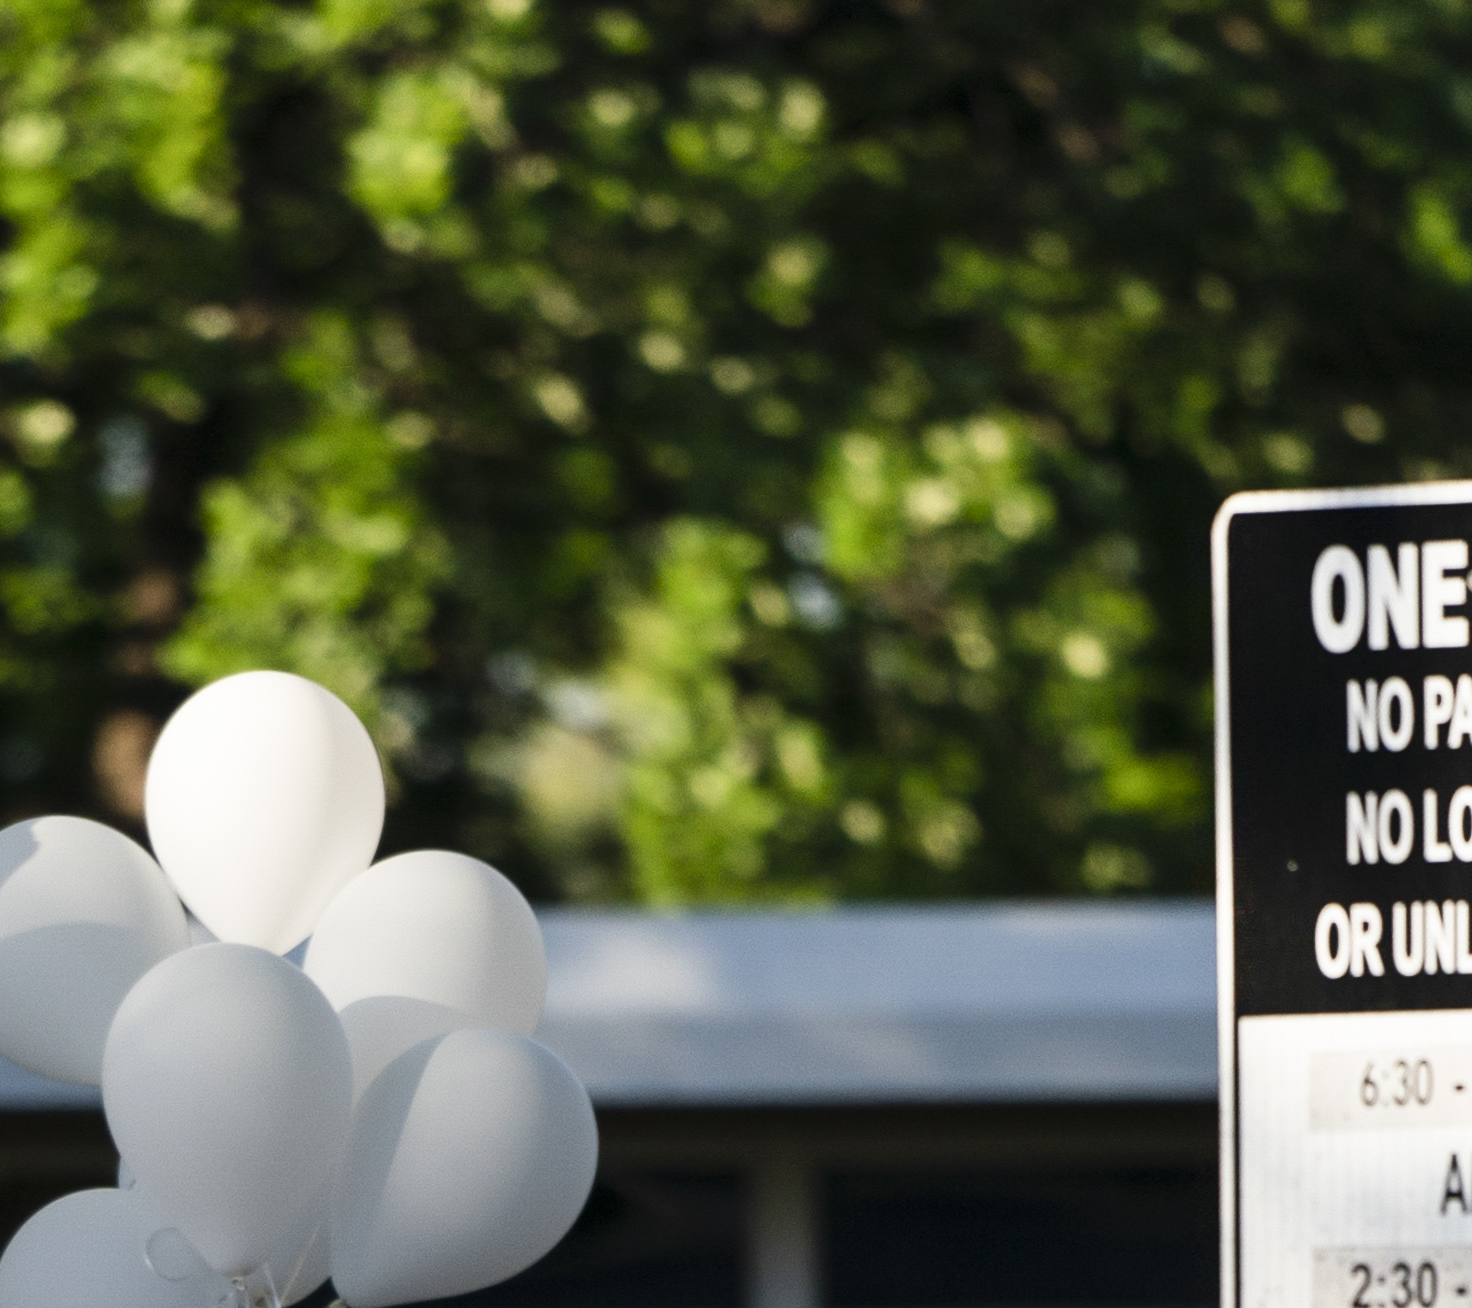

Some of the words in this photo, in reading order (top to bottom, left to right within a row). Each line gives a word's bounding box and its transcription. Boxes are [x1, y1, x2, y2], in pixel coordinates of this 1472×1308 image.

[1311, 541, 1469, 653] ONE
[1347, 678, 1414, 752] NO
[1346, 791, 1414, 865] NO
[1315, 903, 1384, 978] OR
[1360, 1058, 1434, 1109] 6:30
